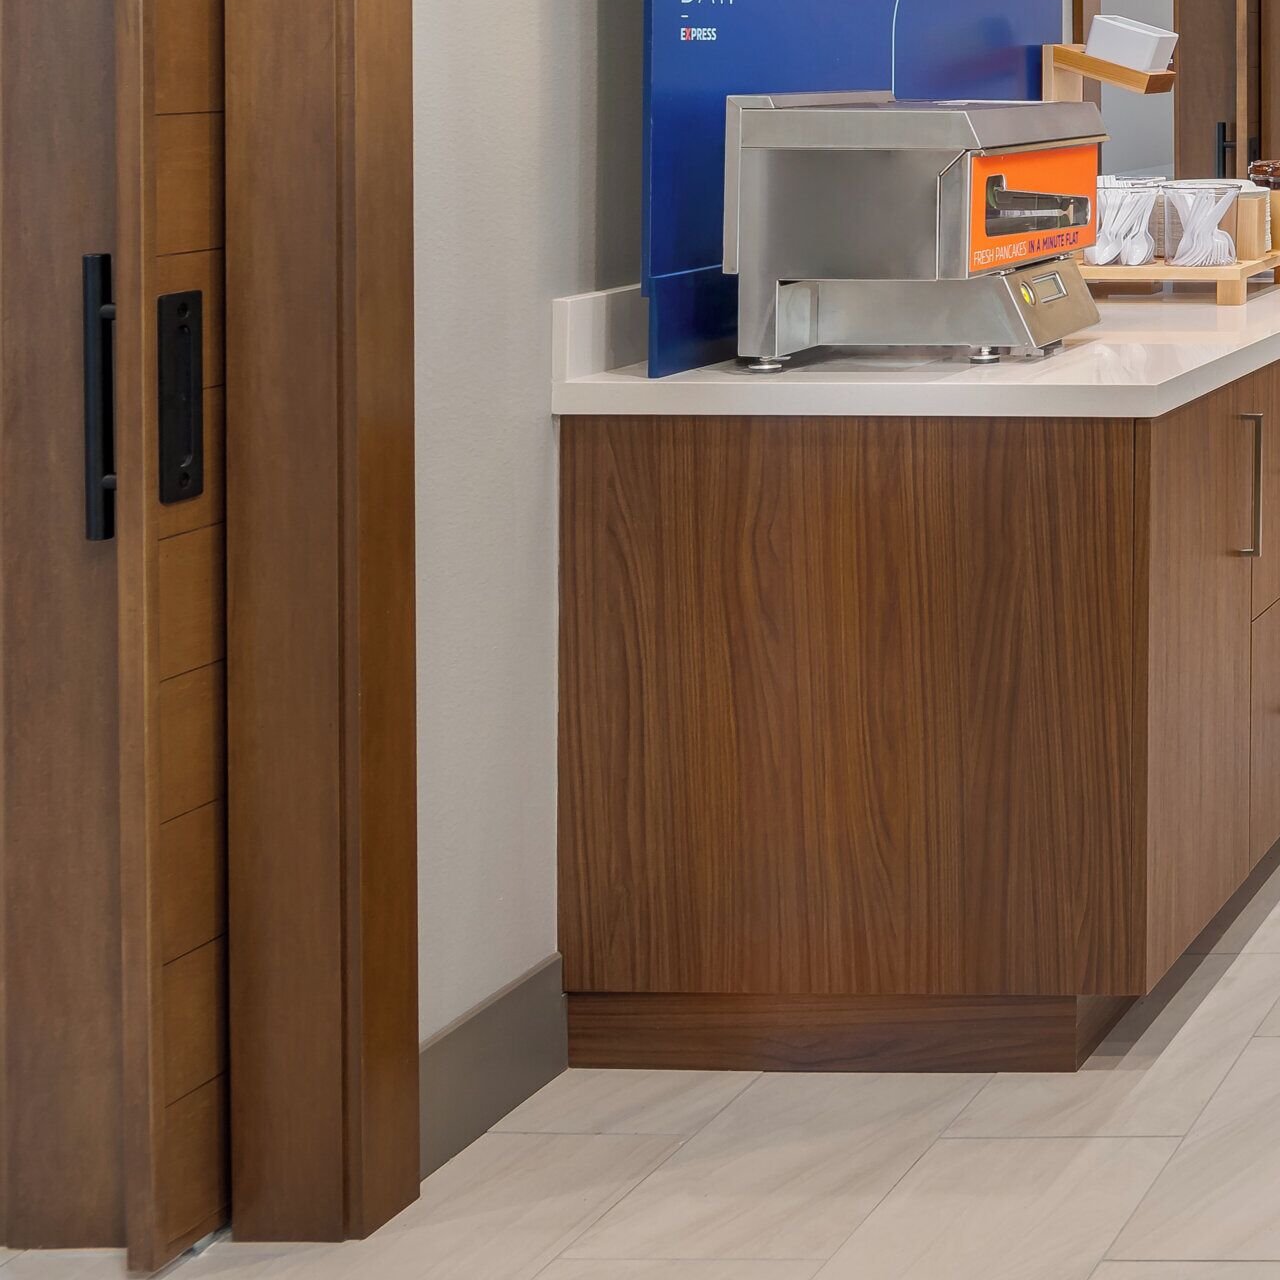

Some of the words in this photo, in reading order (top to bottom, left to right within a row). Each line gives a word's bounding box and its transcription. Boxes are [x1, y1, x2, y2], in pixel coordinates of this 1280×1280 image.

[680, 27, 717, 41] EXPRESS
[974, 247, 995, 266] FRESH
[995, 240, 1026, 262] PANCAKES
[1028, 240, 1035, 253] IN
[1036, 240, 1040, 252] A
[1043, 234, 1064, 249] MINUTE
[1066, 231, 1079, 246] FLAT
